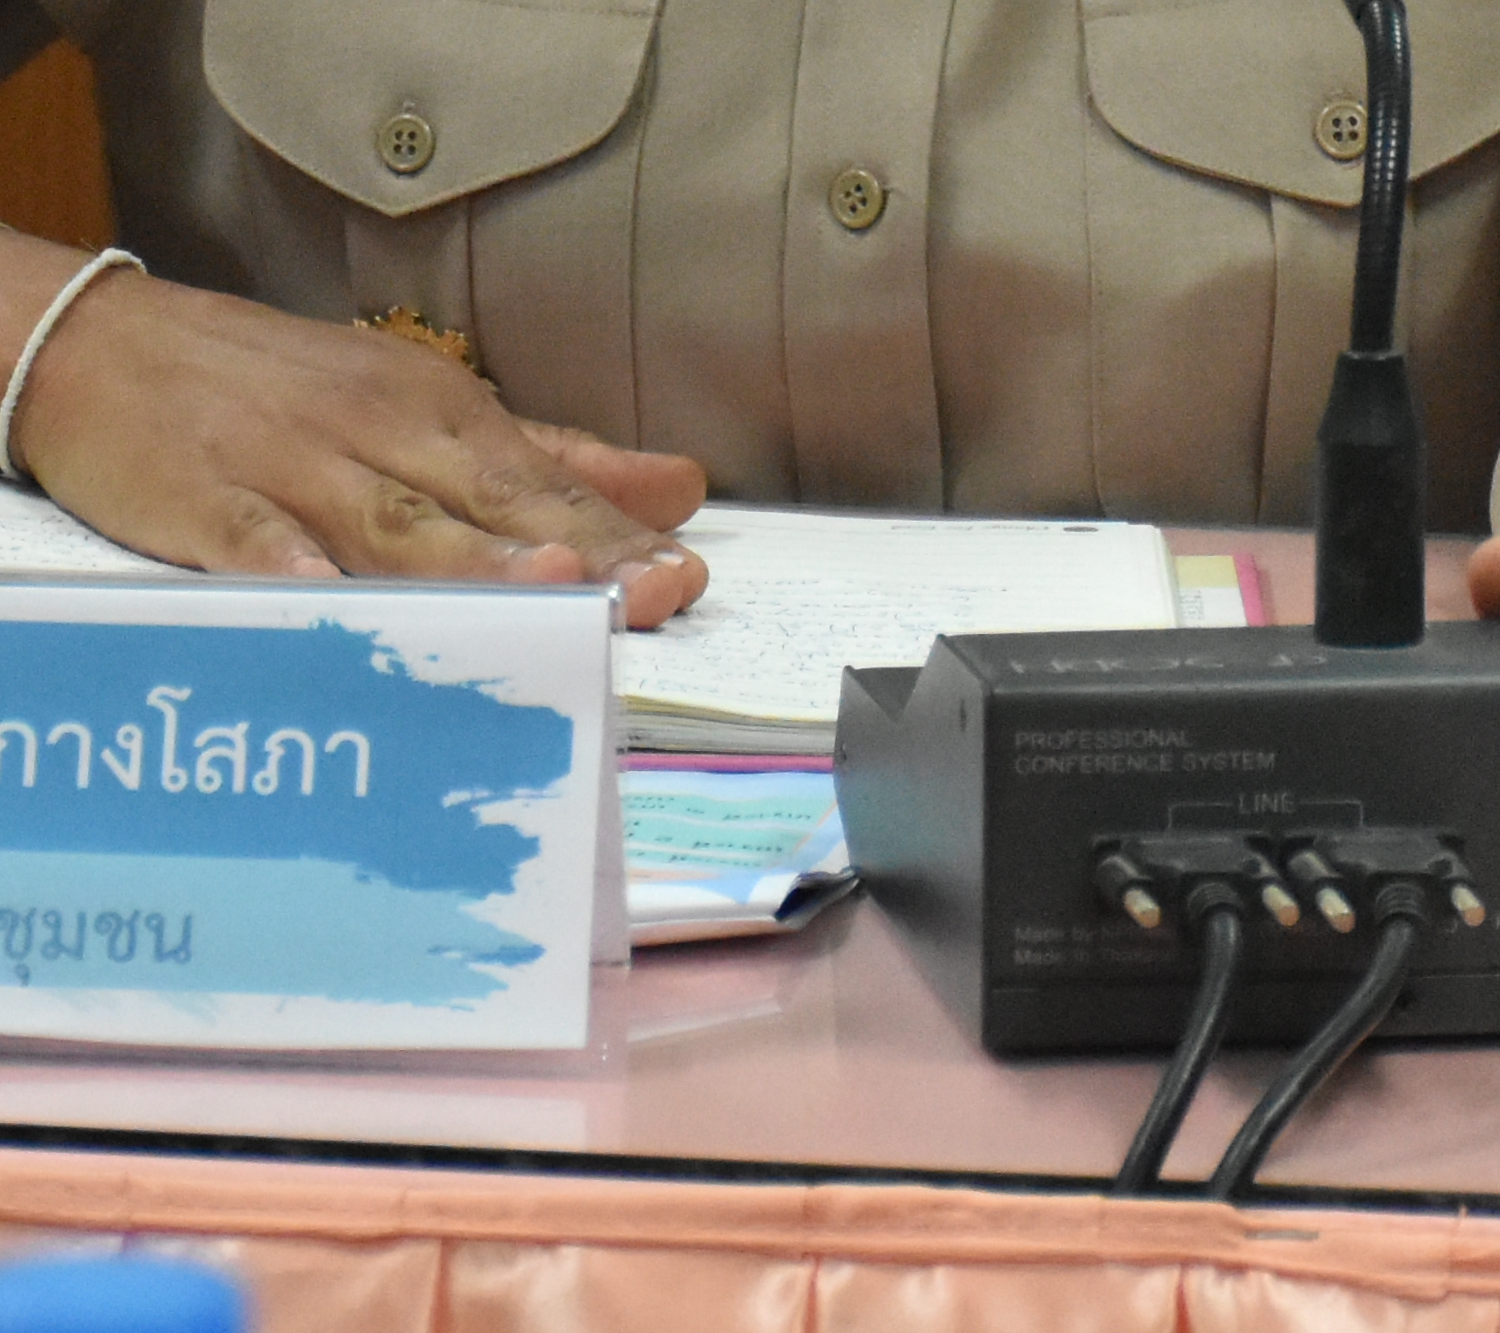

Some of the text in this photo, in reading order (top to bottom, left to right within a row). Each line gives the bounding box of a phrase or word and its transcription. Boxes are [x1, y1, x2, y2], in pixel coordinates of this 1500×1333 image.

[1013, 728, 1193, 750] PROFESSIONAL
[1013, 749, 1277, 776] CONFERENCE SYSTEM
[1237, 789, 1297, 815] LINE
